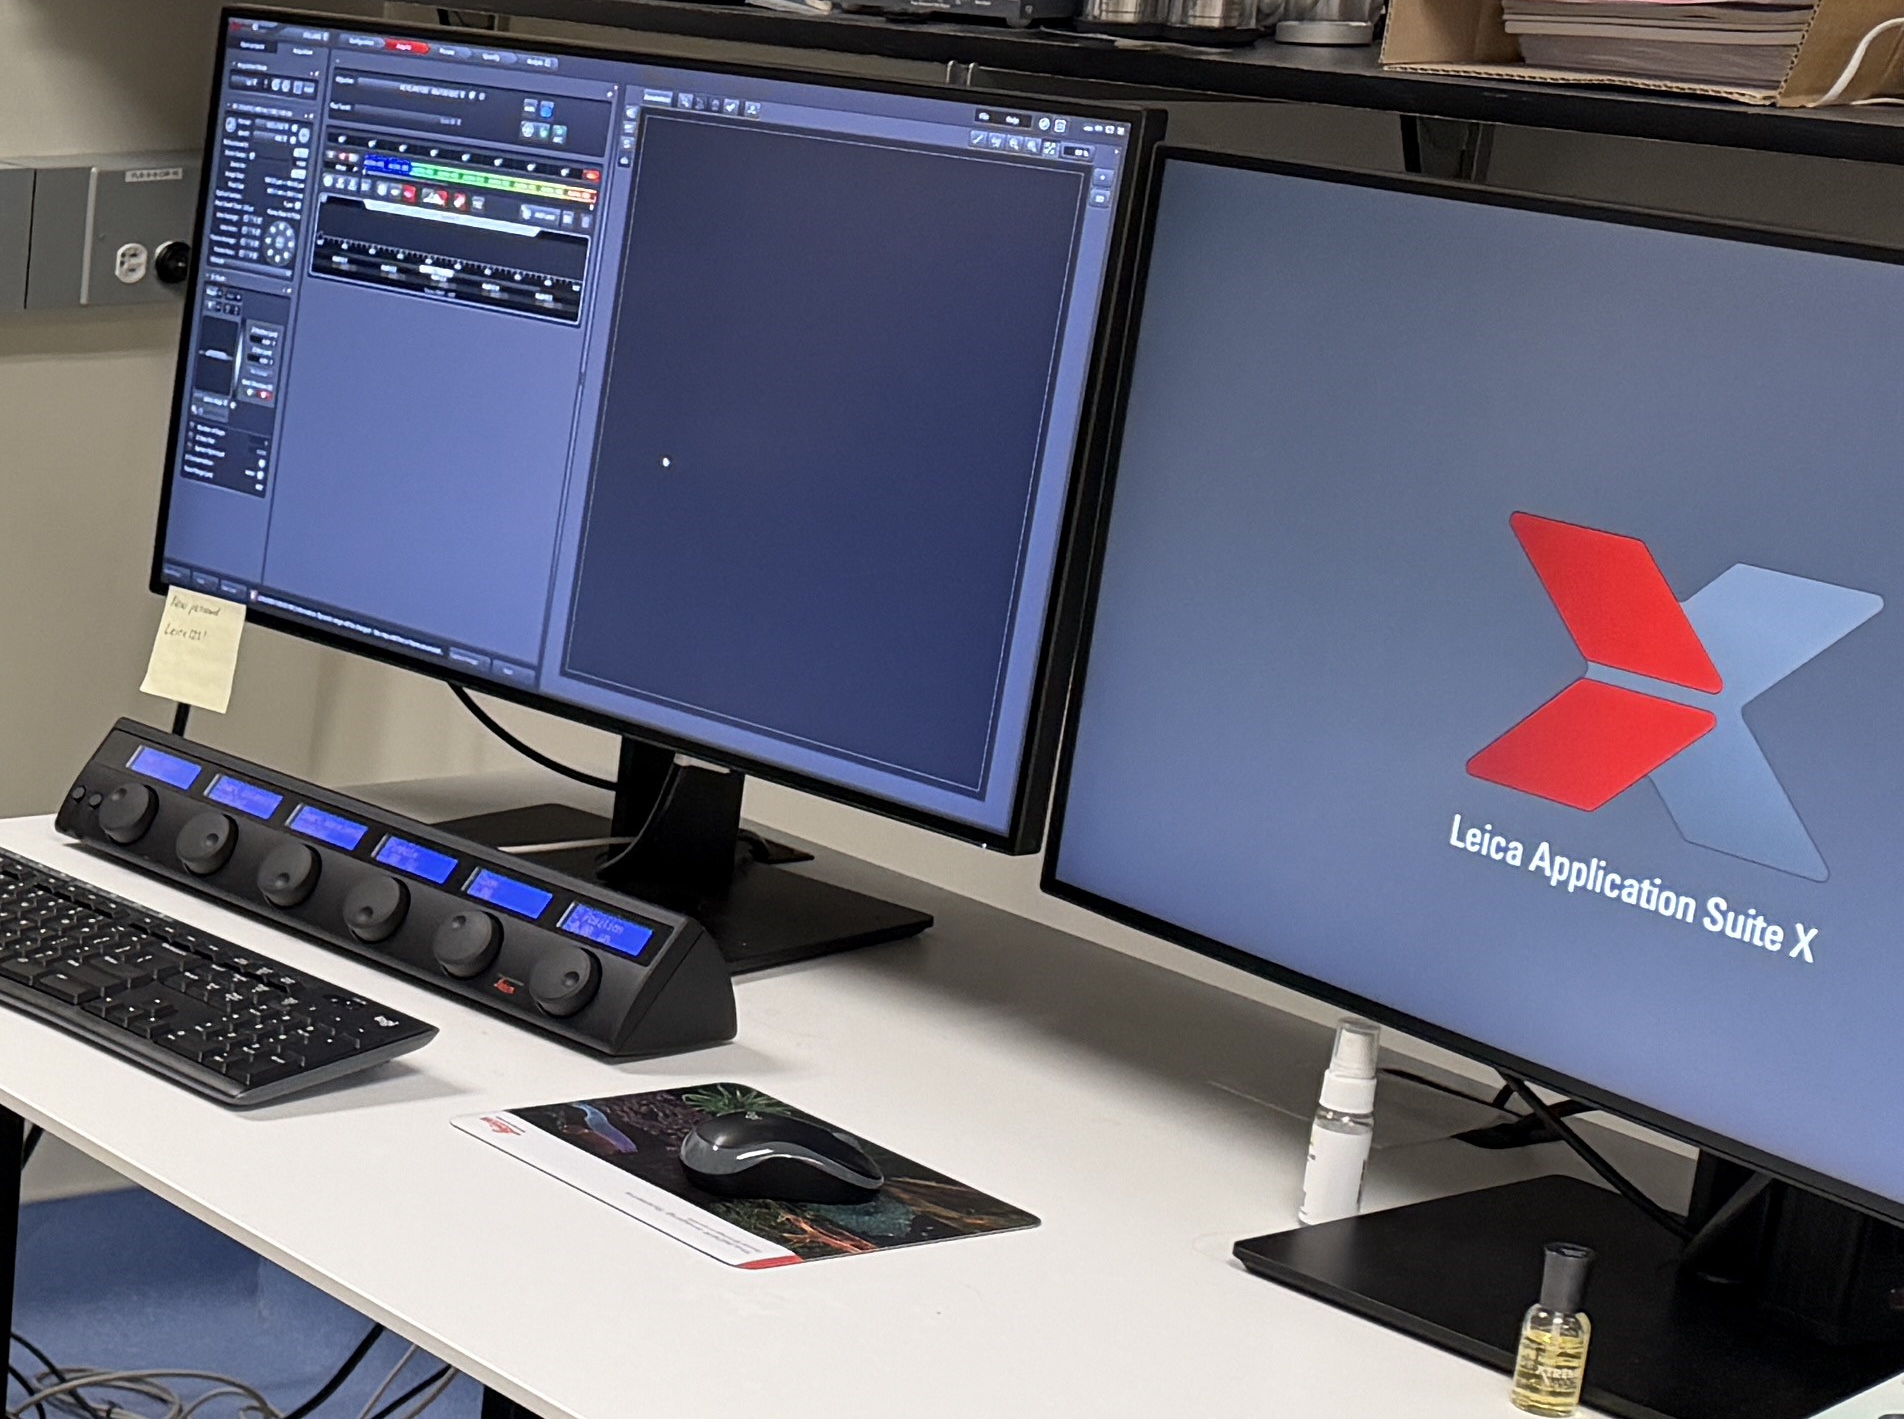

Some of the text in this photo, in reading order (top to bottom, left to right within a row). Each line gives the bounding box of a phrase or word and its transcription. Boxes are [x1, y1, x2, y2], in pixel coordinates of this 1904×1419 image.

[1449, 814, 1819, 963] Leica Application Suite X
